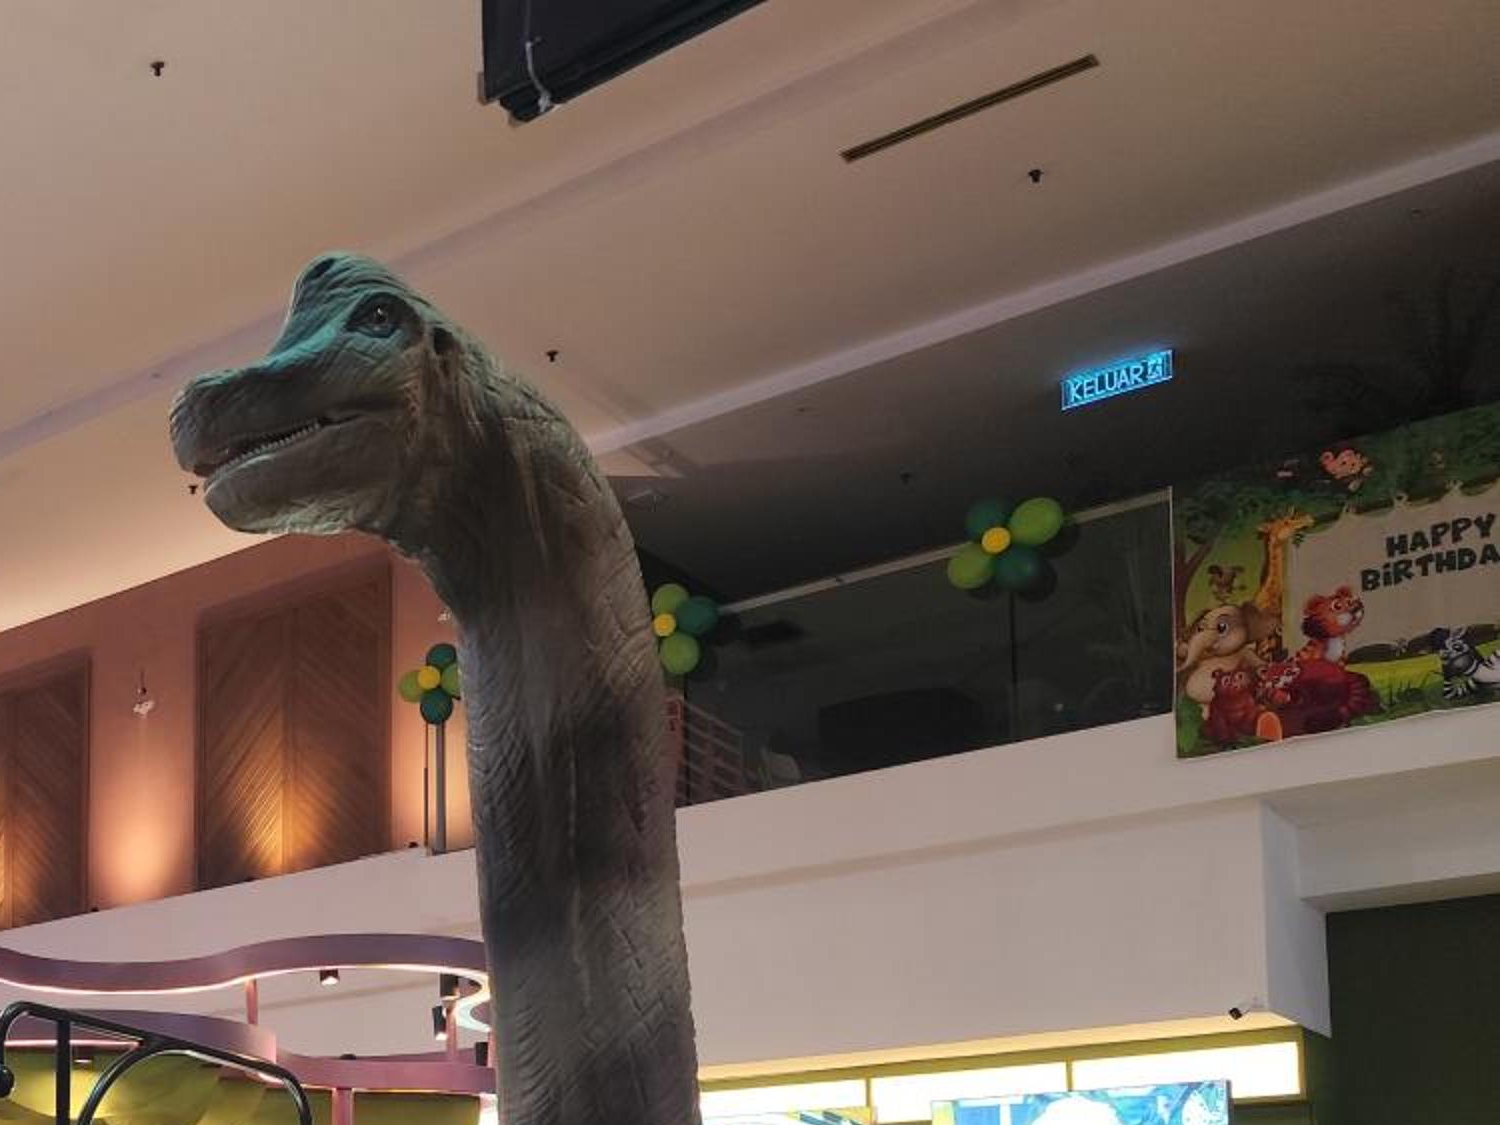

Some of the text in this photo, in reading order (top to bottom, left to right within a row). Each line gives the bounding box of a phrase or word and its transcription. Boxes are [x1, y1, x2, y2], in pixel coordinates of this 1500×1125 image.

[1070, 365, 1145, 402] KELUAR
[1385, 513, 1496, 558] HAPPY
[1361, 543, 1500, 592] BiRTHDA
